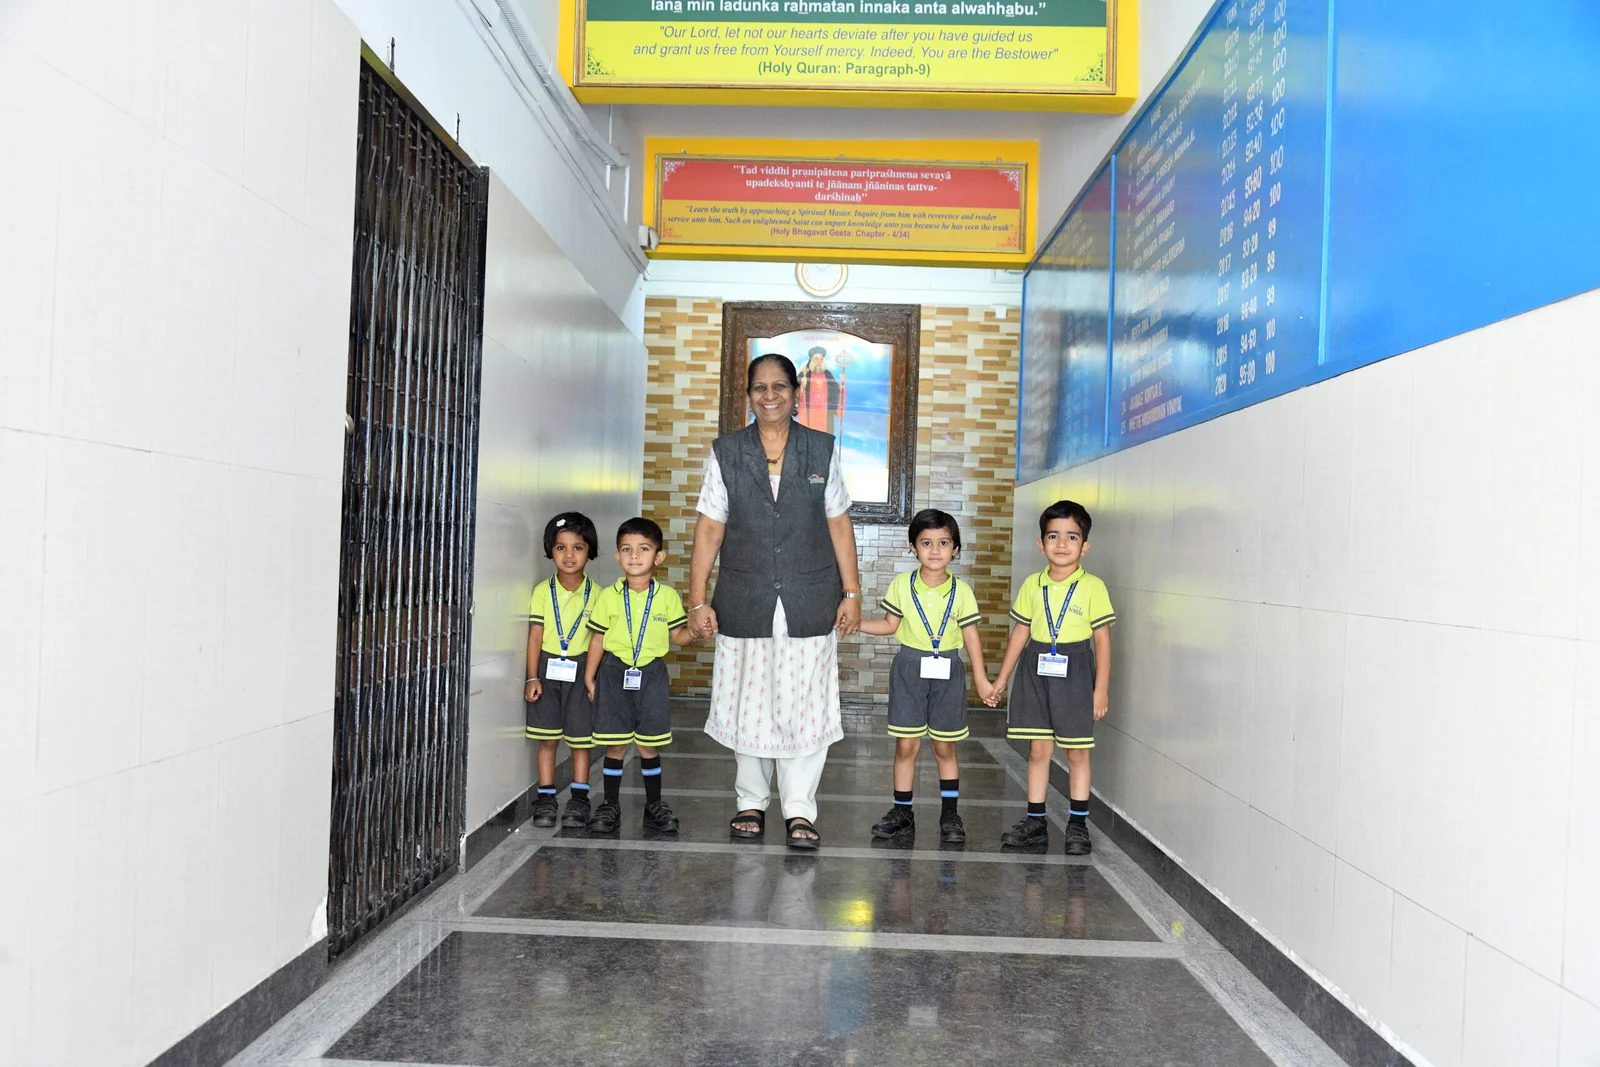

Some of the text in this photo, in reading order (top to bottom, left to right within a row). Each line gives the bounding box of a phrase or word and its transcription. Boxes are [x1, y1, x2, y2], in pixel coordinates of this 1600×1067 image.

[687, 0, 715, 12] min
[720, 0, 779, 12] ladunka
[859, 0, 910, 14] innaka
[914, 2, 947, 14] anta
[659, 26, 1033, 44] "Our Lord, let not our hearts deviate after you have guided us
[1273, 20, 1287, 48] 100
[633, 43, 1059, 60] and grant us free from Yourself mercy. Indeed, You are the Bestower"
[1272, 47, 1287, 76] 100
[758, 62, 931, 77] (Holy Quran: Paragraph-9)
[1272, 77, 1285, 106] 100
[1271, 106, 1285, 137] 100
[760, 165, 790, 175] viddhi
[1270, 144, 1284, 176] 100
[816, 181, 825, 189] te
[906, 183, 938, 192] tattva-
[1269, 181, 1281, 208] 100
[686, 205, 708, 213] "Learn
[722, 206, 739, 214] truth
[739, 207, 748, 216] by
[749, 207, 790, 216] approaching
[798, 208, 826, 217] Spiritual
[854, 210, 879, 219] Inquire
[879, 210, 896, 219] from
[912, 211, 926, 219] with
[960, 212, 974, 220] and
[975, 213, 997, 221] render
[724, 216, 741, 224] Such
[753, 217, 791, 226] enlightened
[793, 218, 809, 226] Saint
[825, 219, 846, 228] impart
[848, 220, 882, 229] knowledge
[884, 221, 898, 229] unto
[900, 223, 912, 231] you
[914, 222, 940, 230] because
[952, 223, 963, 231] has
[771, 227, 790, 237] (Holy
[792, 228, 827, 237] Bhagavat
[829, 229, 853, 237] Geeta:
[856, 230, 885, 239] Chapter
[892, 231, 910, 239] 4/34)
[1218, 252, 1232, 277] 2017
[1268, 217, 1277, 240] 99
[1267, 250, 1275, 273] 99
[1266, 285, 1275, 307] 99
[1266, 318, 1276, 340] 100
[1265, 349, 1275, 375] 100
